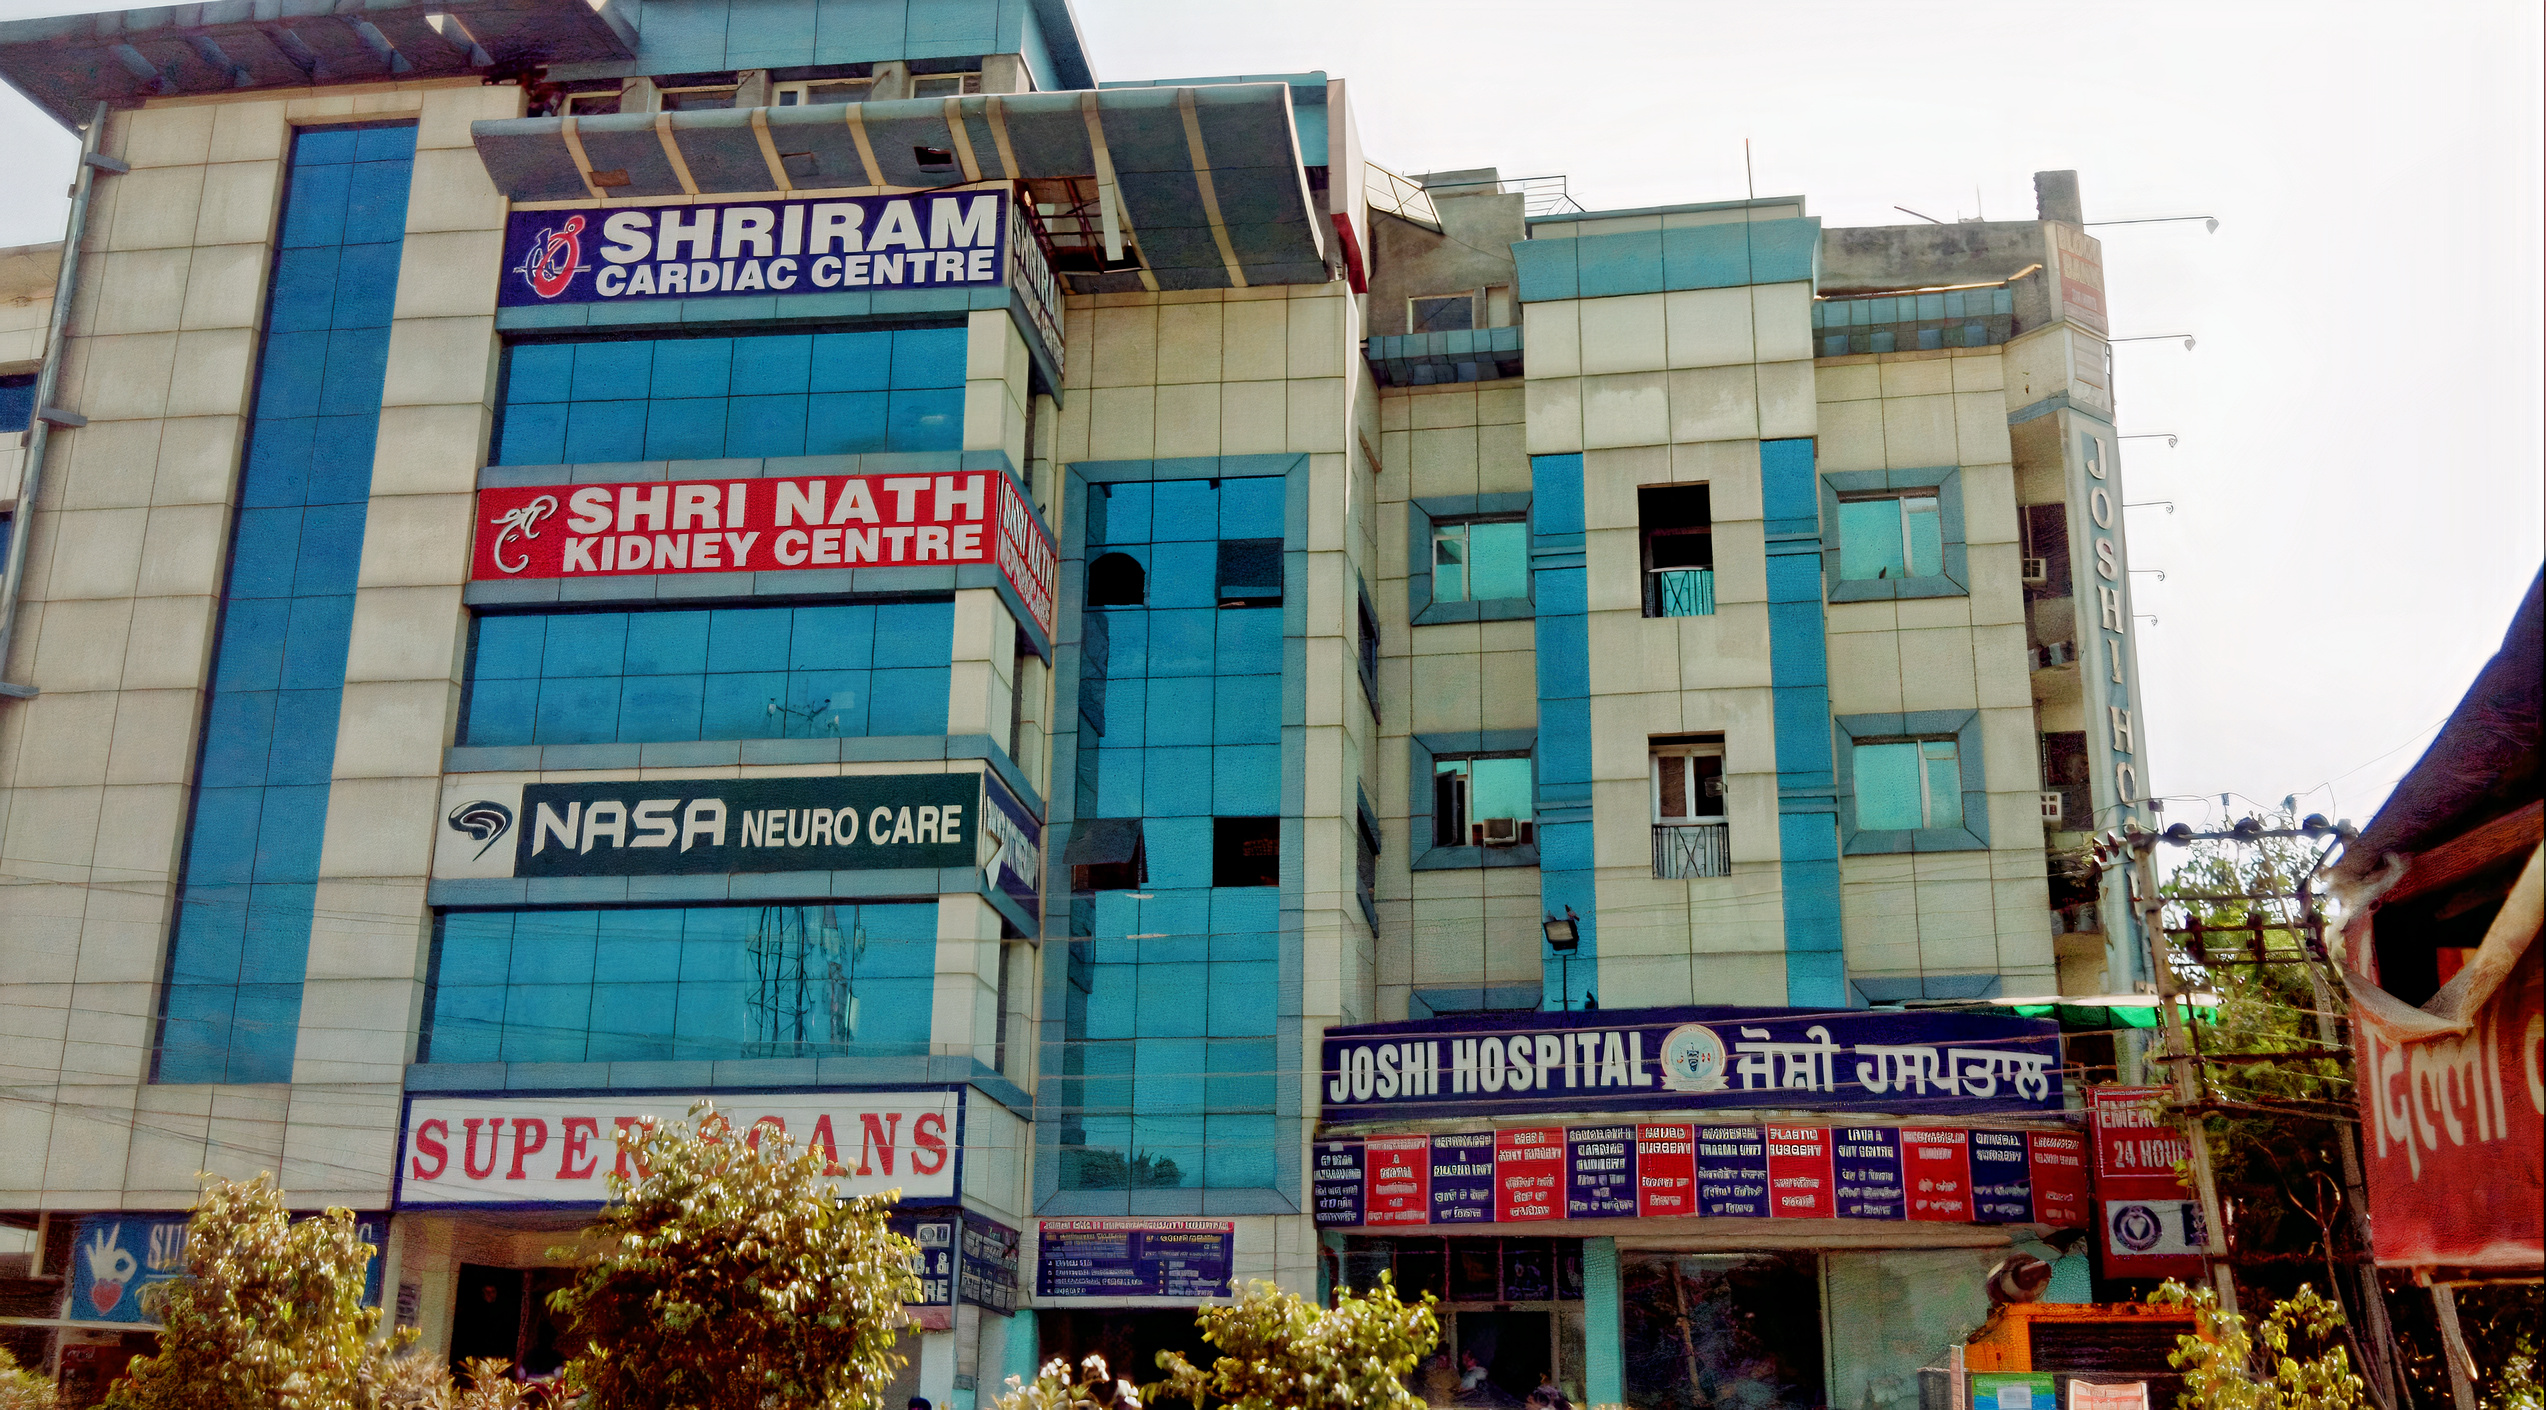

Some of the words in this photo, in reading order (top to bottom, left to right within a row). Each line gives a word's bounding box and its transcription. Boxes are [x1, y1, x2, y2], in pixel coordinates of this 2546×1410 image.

[600, 195, 998, 263] SHRIRAM
[595, 257, 798, 297] CARDIAC
[812, 249, 995, 288] CENTRE
[566, 484, 748, 534] SHRI
[775, 475, 985, 527] NATH
[562, 531, 760, 573] KIDNEY
[774, 524, 983, 566] CENTRE
[2087, 437, 2124, 684] JOSHI
[531, 798, 727, 856] NASA
[741, 807, 858, 849] NEURO
[868, 805, 962, 845] CARE
[1330, 1040, 1438, 1103] JOSHI
[1452, 1031, 1652, 1093] HOSPITAL
[1855, 1044, 2053, 1100] ਹਸਪਤਾਲ
[412, 1117, 654, 1180] SUPER
